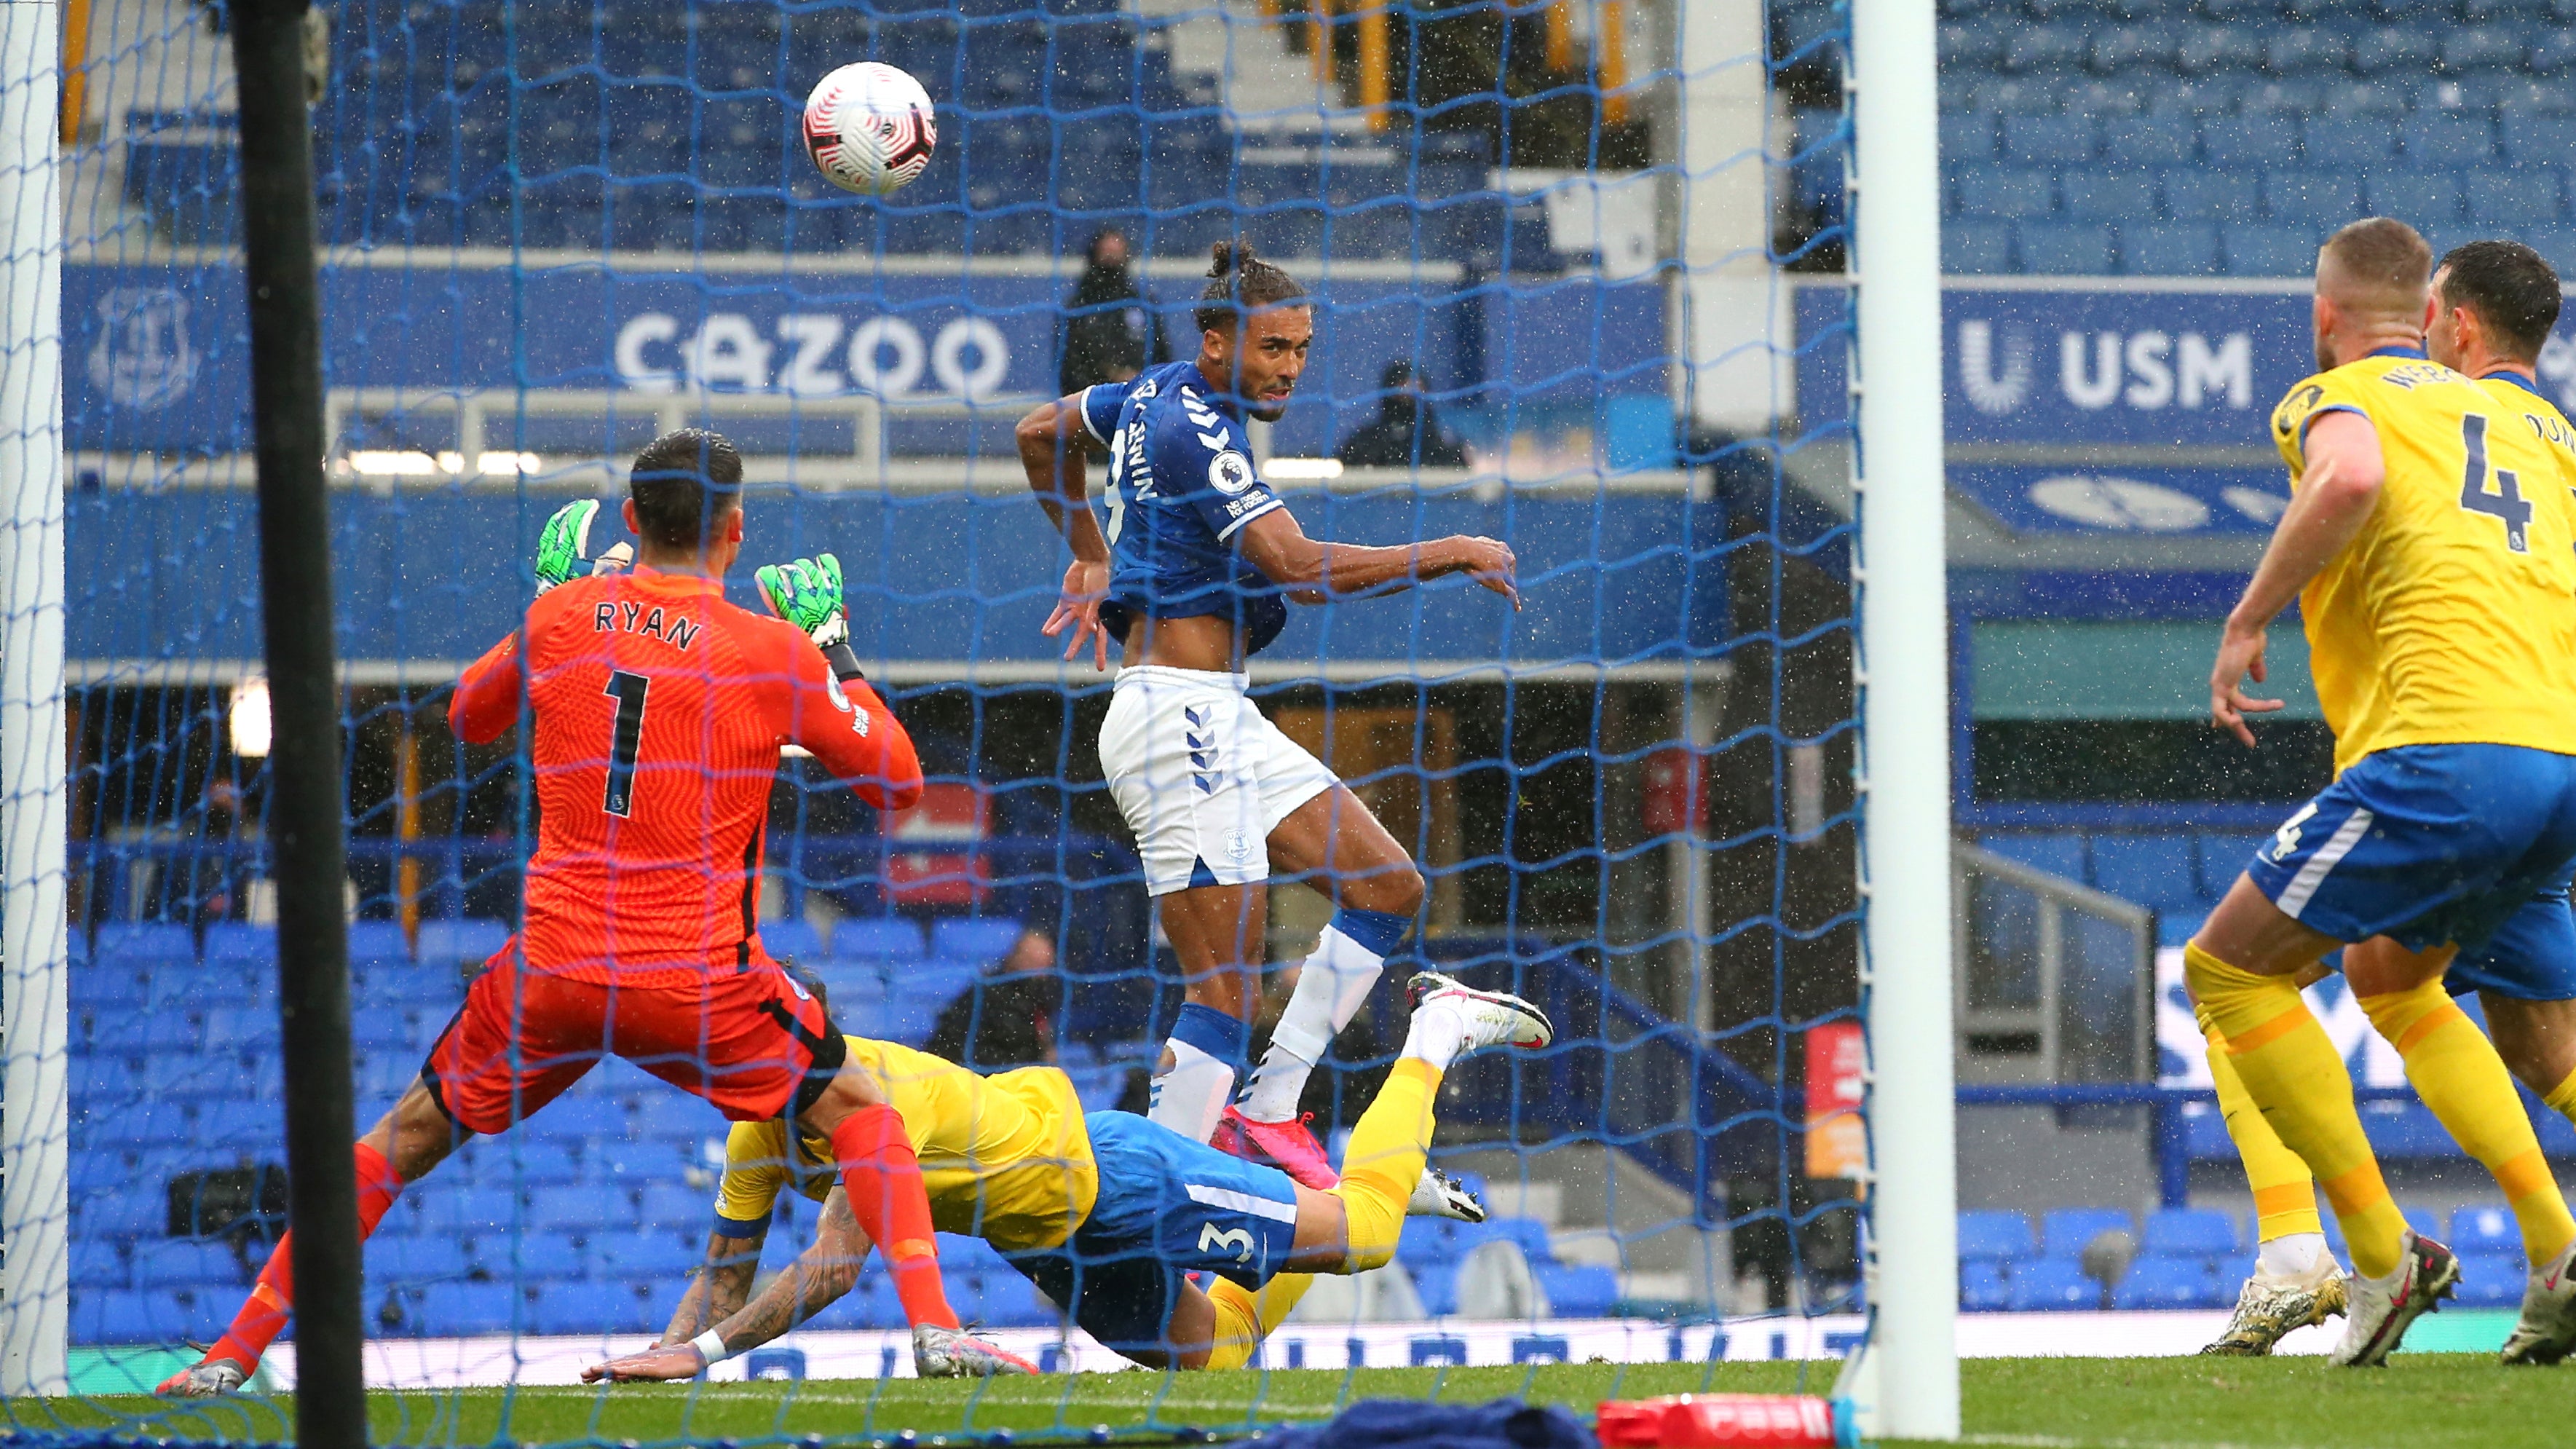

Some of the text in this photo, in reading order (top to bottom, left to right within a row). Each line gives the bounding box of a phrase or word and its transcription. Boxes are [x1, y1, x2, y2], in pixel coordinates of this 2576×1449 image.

[615, 312, 1011, 396] CAZOO
[2059, 328, 2253, 411] USM
[2462, 413, 2532, 553] 4
[593, 601, 701, 652] RYAN
[602, 668, 650, 818] 1
[2272, 802, 2319, 862] 4
[1198, 1221, 1255, 1264] 3
